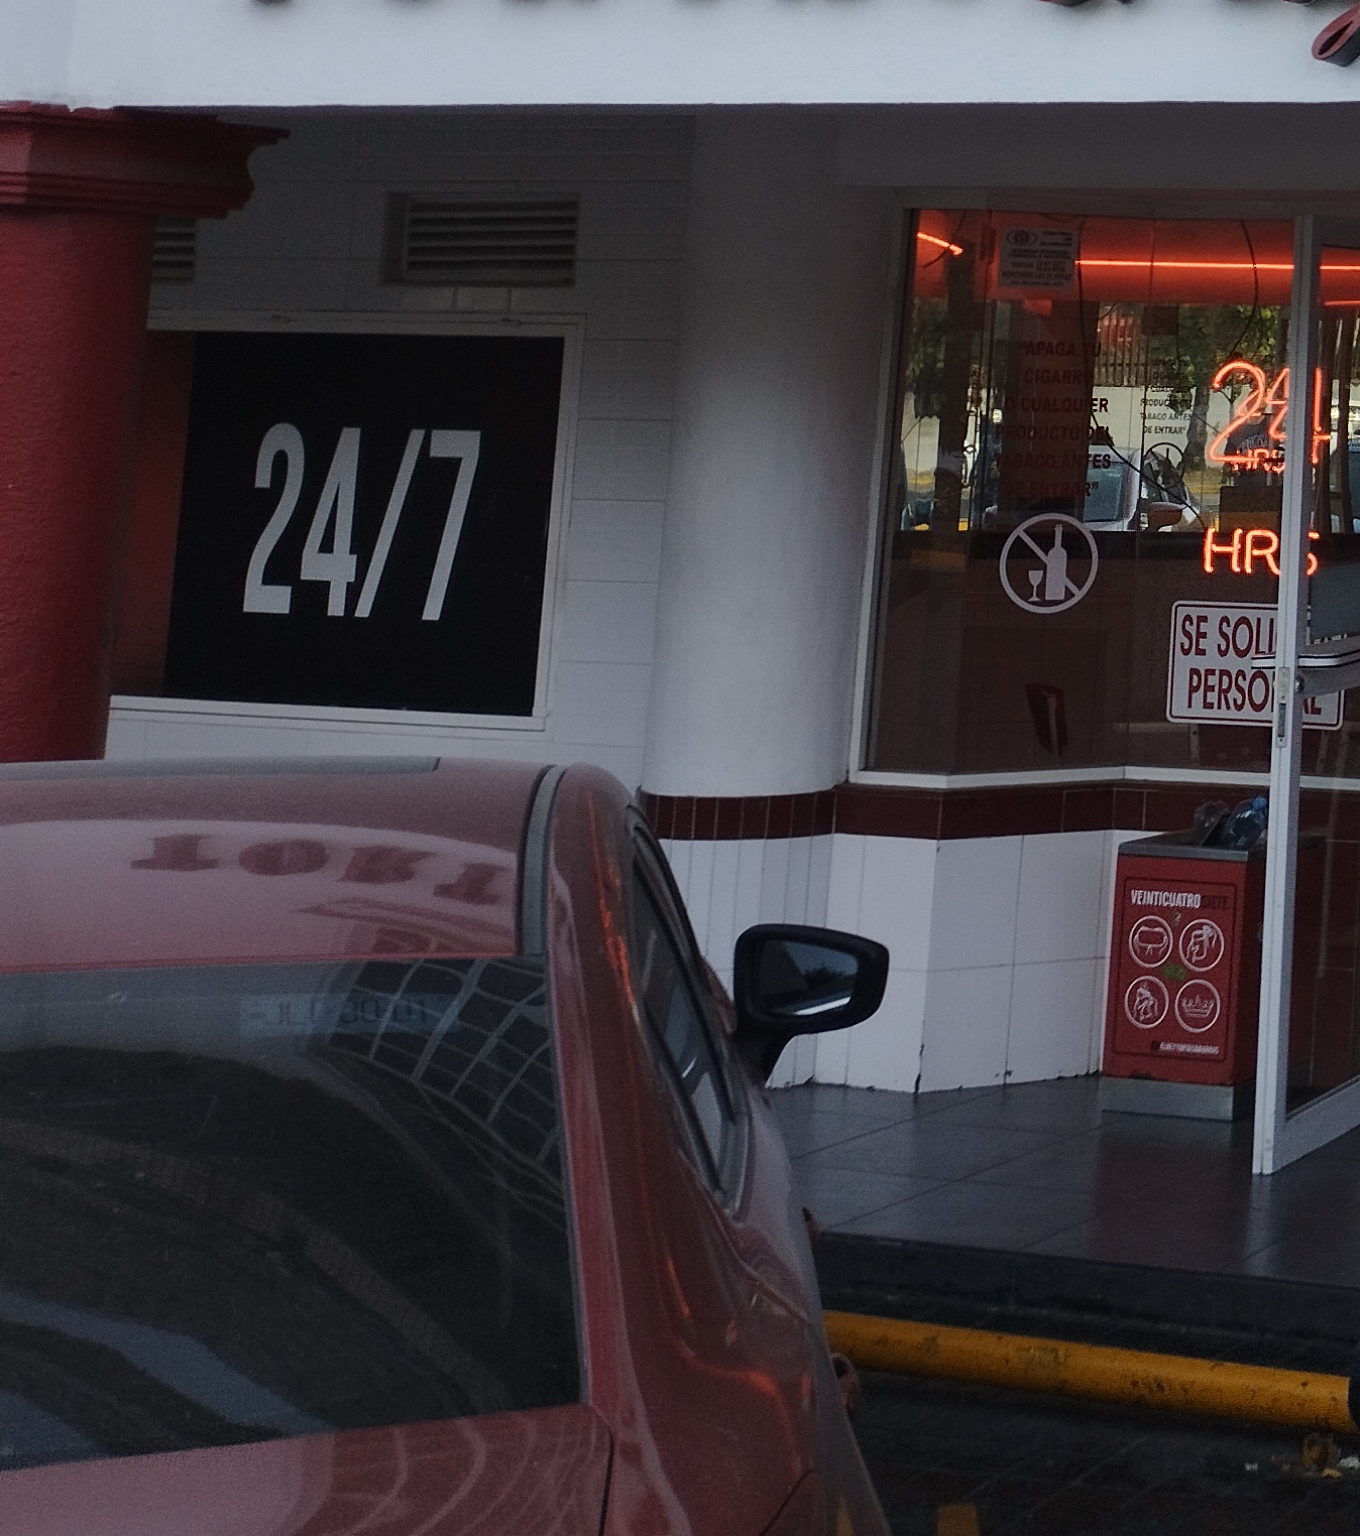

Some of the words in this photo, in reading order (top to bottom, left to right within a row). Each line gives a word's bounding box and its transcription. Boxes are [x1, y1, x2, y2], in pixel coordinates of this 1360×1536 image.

[1023, 368, 1091, 384] CIGARR
[242, 421, 482, 621] 24/7
[1179, 614, 1209, 657] SE
[1187, 667, 1322, 716] PERSO
